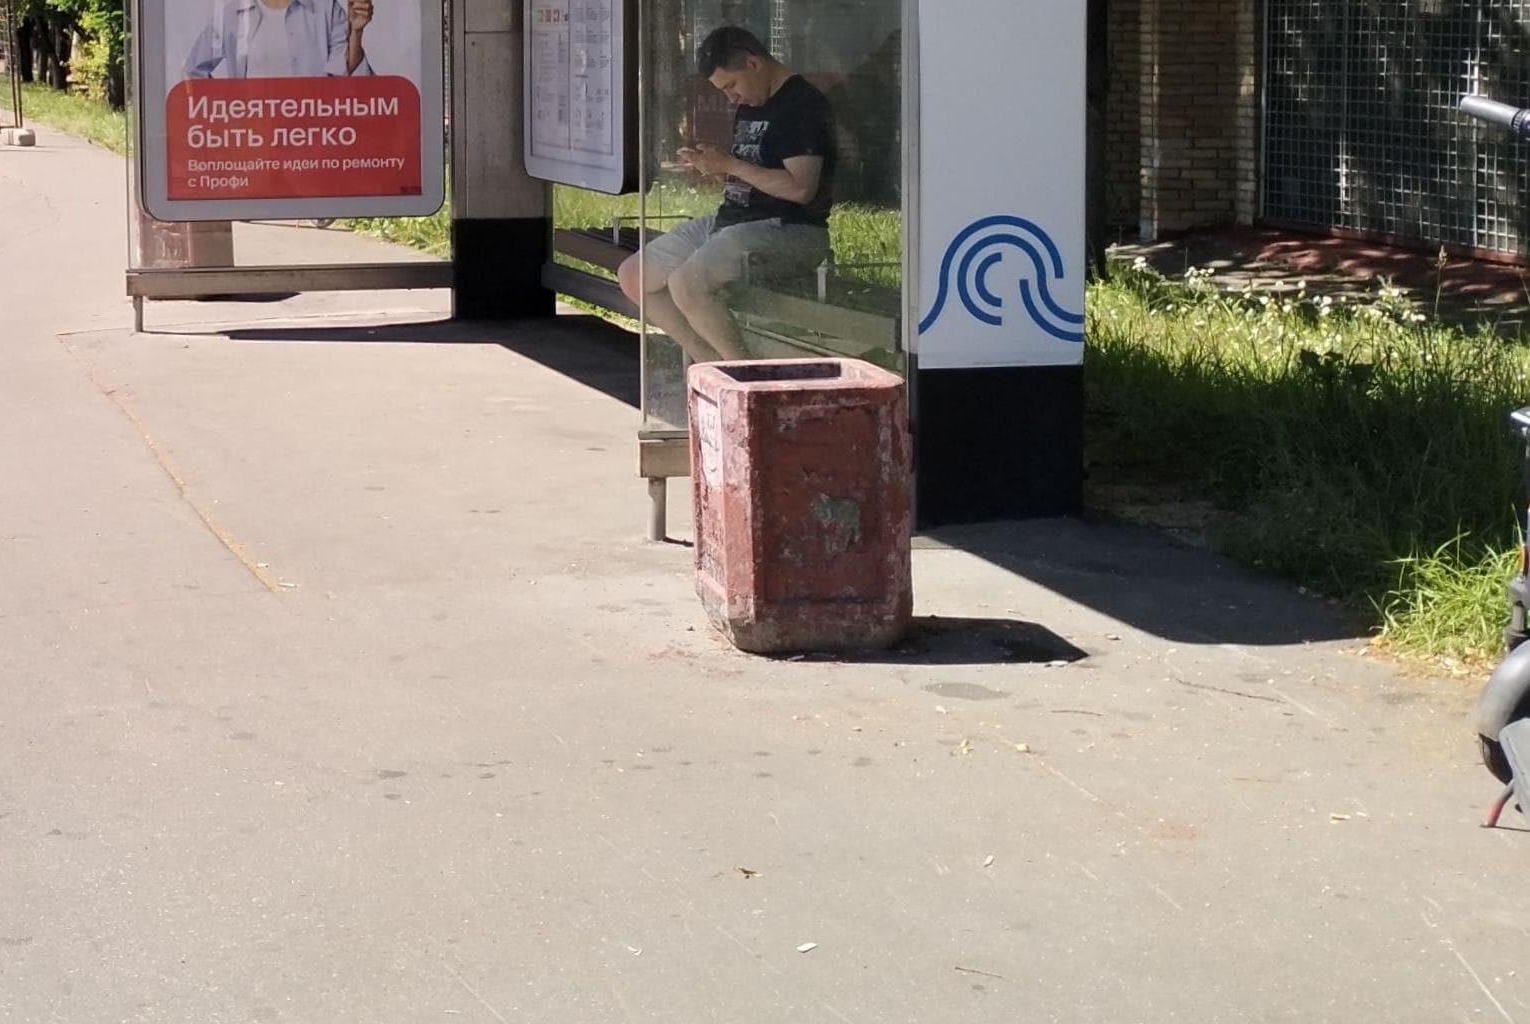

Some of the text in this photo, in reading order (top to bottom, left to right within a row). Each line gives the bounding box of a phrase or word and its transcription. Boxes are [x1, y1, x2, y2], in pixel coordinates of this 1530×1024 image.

[187, 95, 399, 123] Идеятельным
[187, 124, 357, 149] быть легко
[188, 156, 405, 173] Воплощайте идеи по ремонту
[188, 175, 249, 189] с Профи
